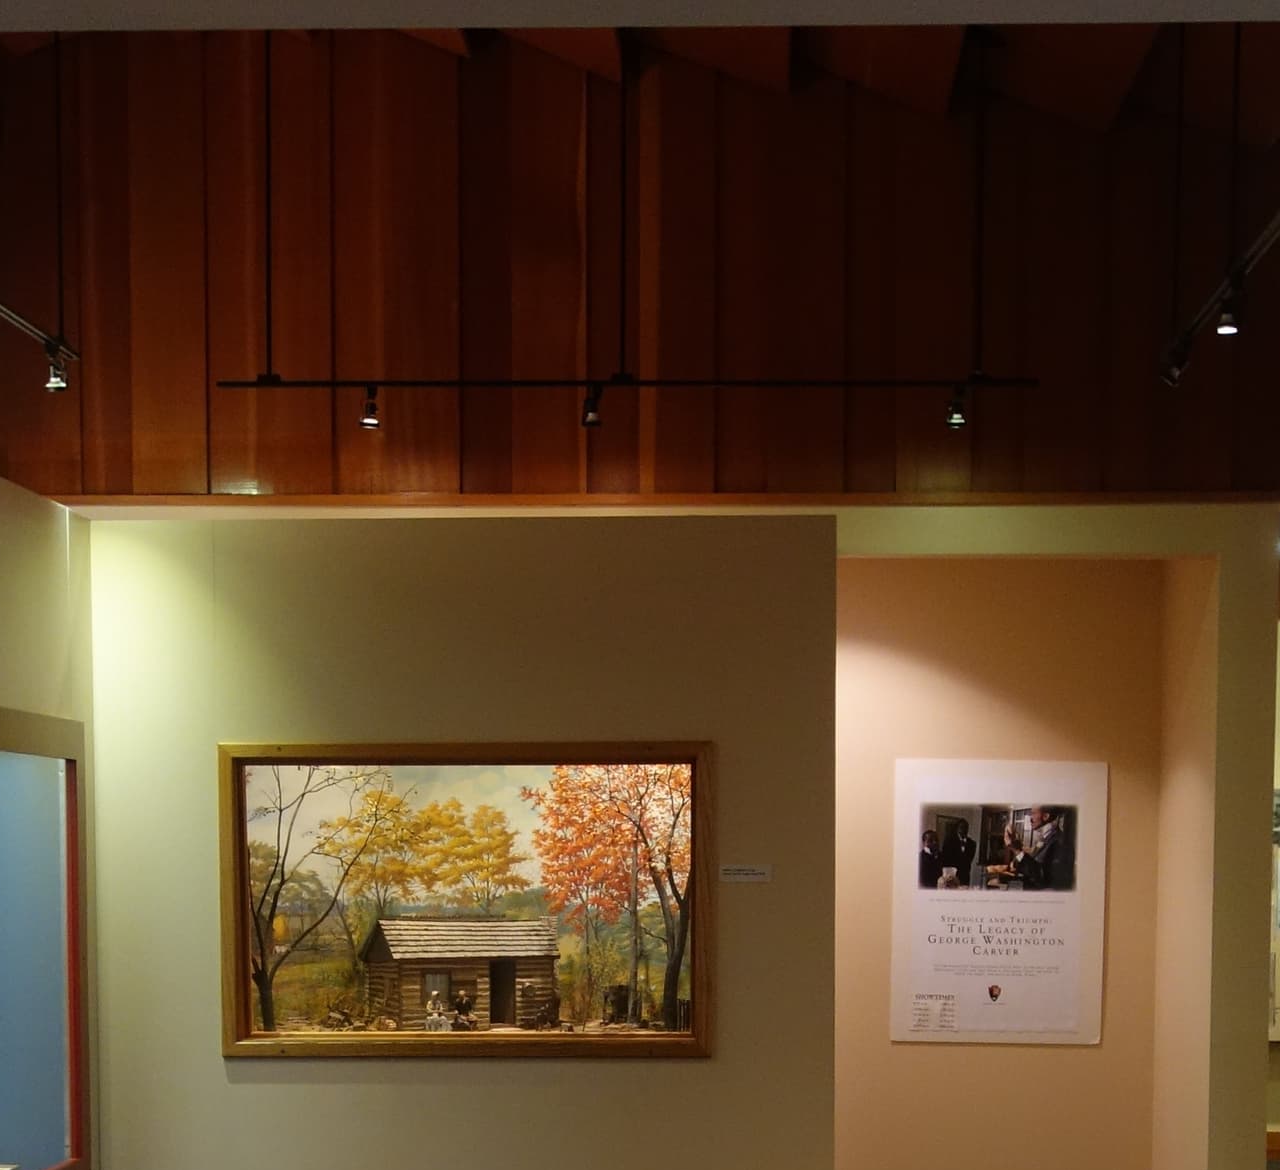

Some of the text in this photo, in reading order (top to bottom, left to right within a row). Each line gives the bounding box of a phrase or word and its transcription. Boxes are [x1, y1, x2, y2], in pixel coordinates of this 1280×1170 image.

[928, 934, 1065, 946] GEORGE WASHINGTON
[972, 946, 1019, 956] CARVER
